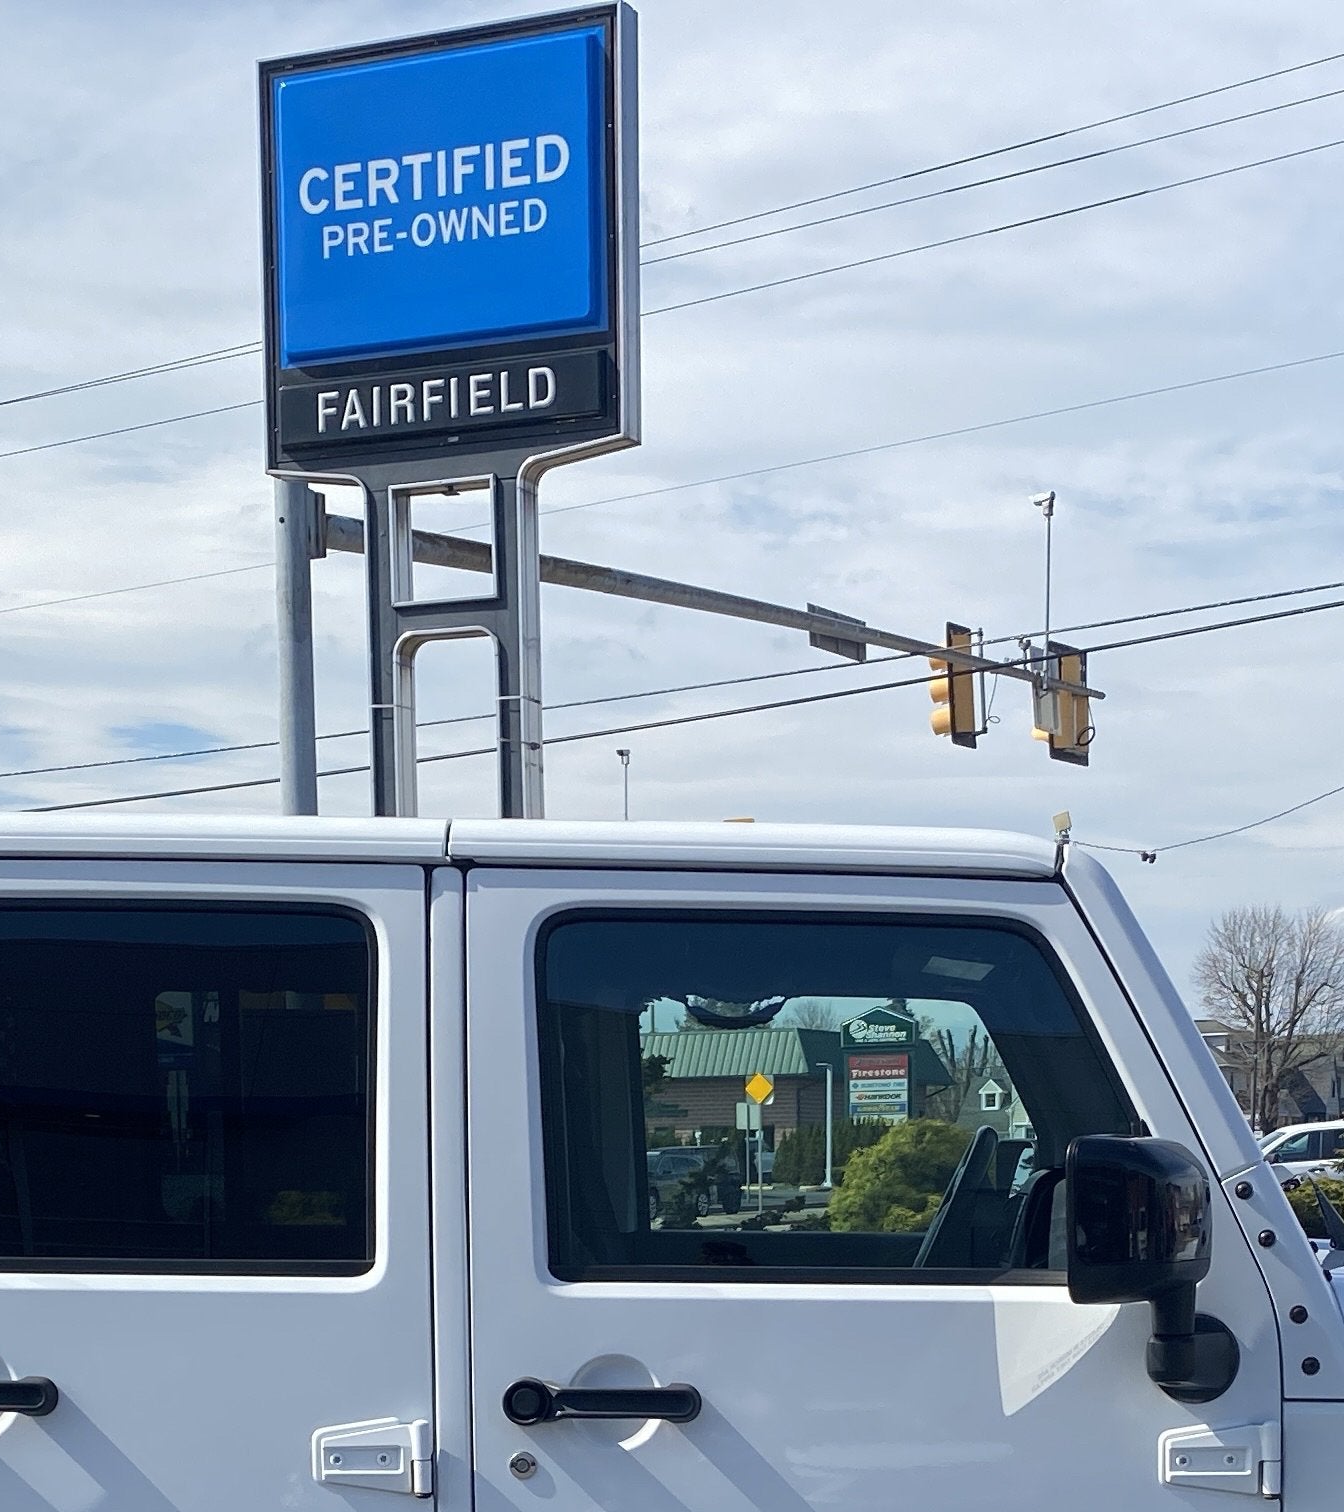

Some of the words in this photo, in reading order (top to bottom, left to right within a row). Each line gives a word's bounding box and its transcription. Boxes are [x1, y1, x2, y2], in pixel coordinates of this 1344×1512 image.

[299, 134, 570, 215] CERTIFIED
[322, 198, 548, 259] PRE-OWNED
[317, 366, 557, 433] FAIRFIELD
[852, 1070, 905, 1078] Firestone
